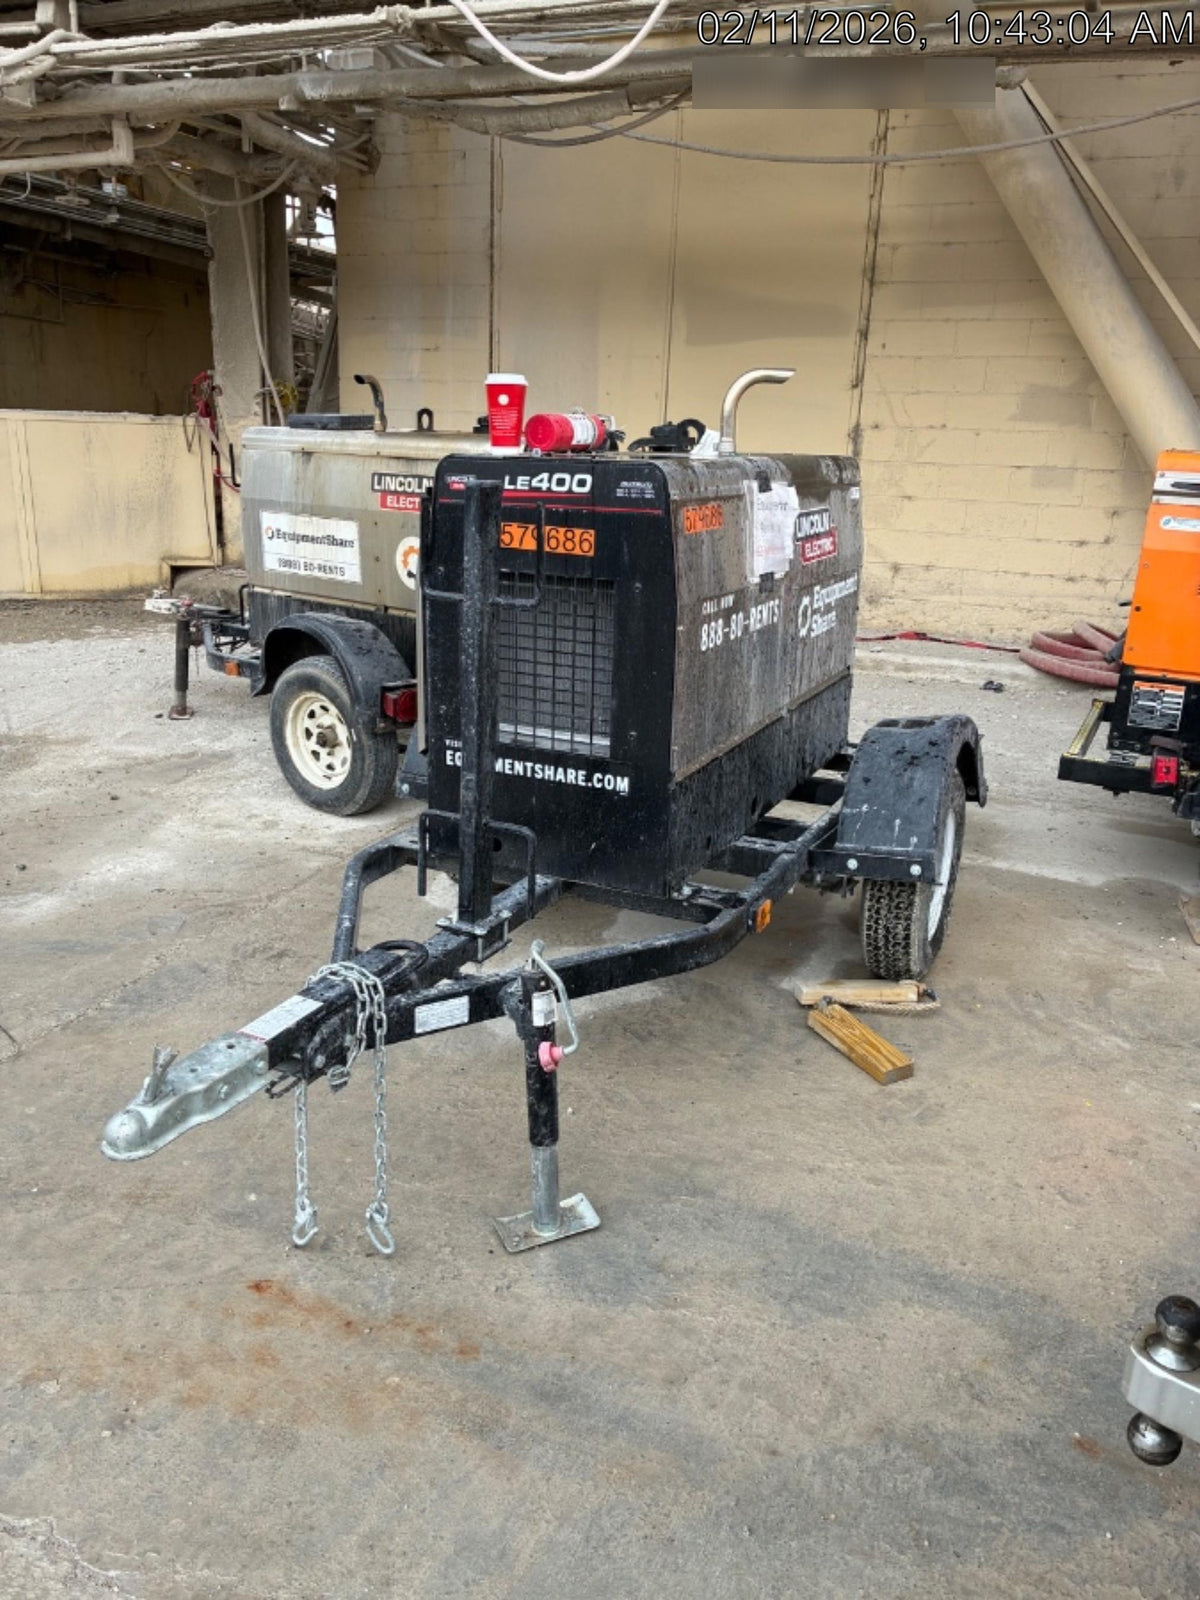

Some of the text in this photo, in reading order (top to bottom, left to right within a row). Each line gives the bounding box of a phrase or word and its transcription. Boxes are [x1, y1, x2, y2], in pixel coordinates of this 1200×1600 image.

[503, 472, 593, 494] LE400
[386, 495, 420, 509] ELECT
[796, 510, 830, 539] LINCOLN
[275, 527, 355, 548] EquipmentShare
[804, 536, 835, 559] ELECTRIC
[701, 598, 780, 652] 888-80-RENTS
